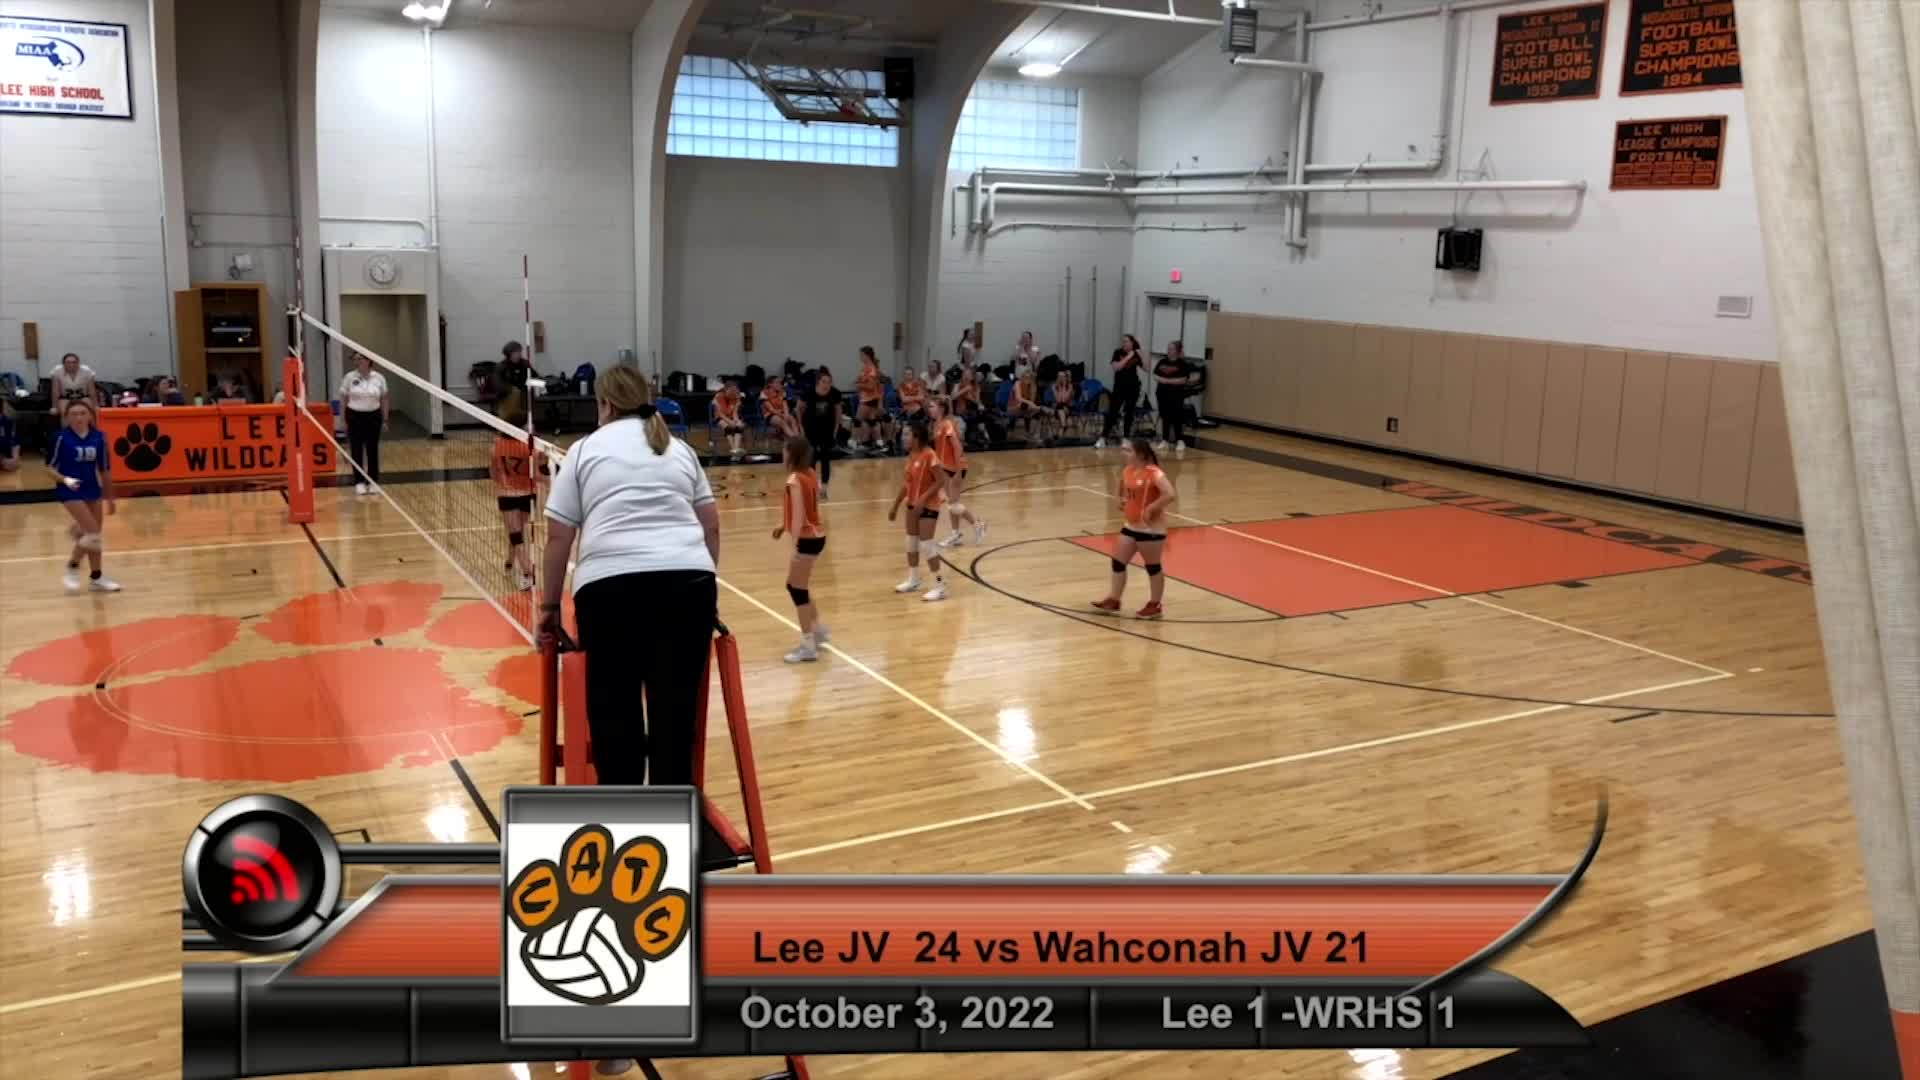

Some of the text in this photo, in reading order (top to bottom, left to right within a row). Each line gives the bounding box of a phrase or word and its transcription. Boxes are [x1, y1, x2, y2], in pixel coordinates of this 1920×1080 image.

[1642, 18, 1736, 41] FOOTBALL
[17, 43, 52, 56] MIAA
[1503, 35, 1593, 56] FOOTBALL
[1639, 35, 1737, 58] SUPER BOWL
[1503, 51, 1593, 71] SUPER BOWL
[1634, 51, 1740, 75] CHAMPIONS
[1501, 66, 1593, 85] CHAMPIONS
[1664, 72, 1703, 87] 1994
[0, 83, 104, 101] LEE HIGH SCHOOL
[1634, 122, 1704, 136] LEE HIGH
[1629, 151, 1702, 161] FOOTBALL
[222, 415, 286, 440] LEE
[185, 443, 327, 471] WILDCAS
